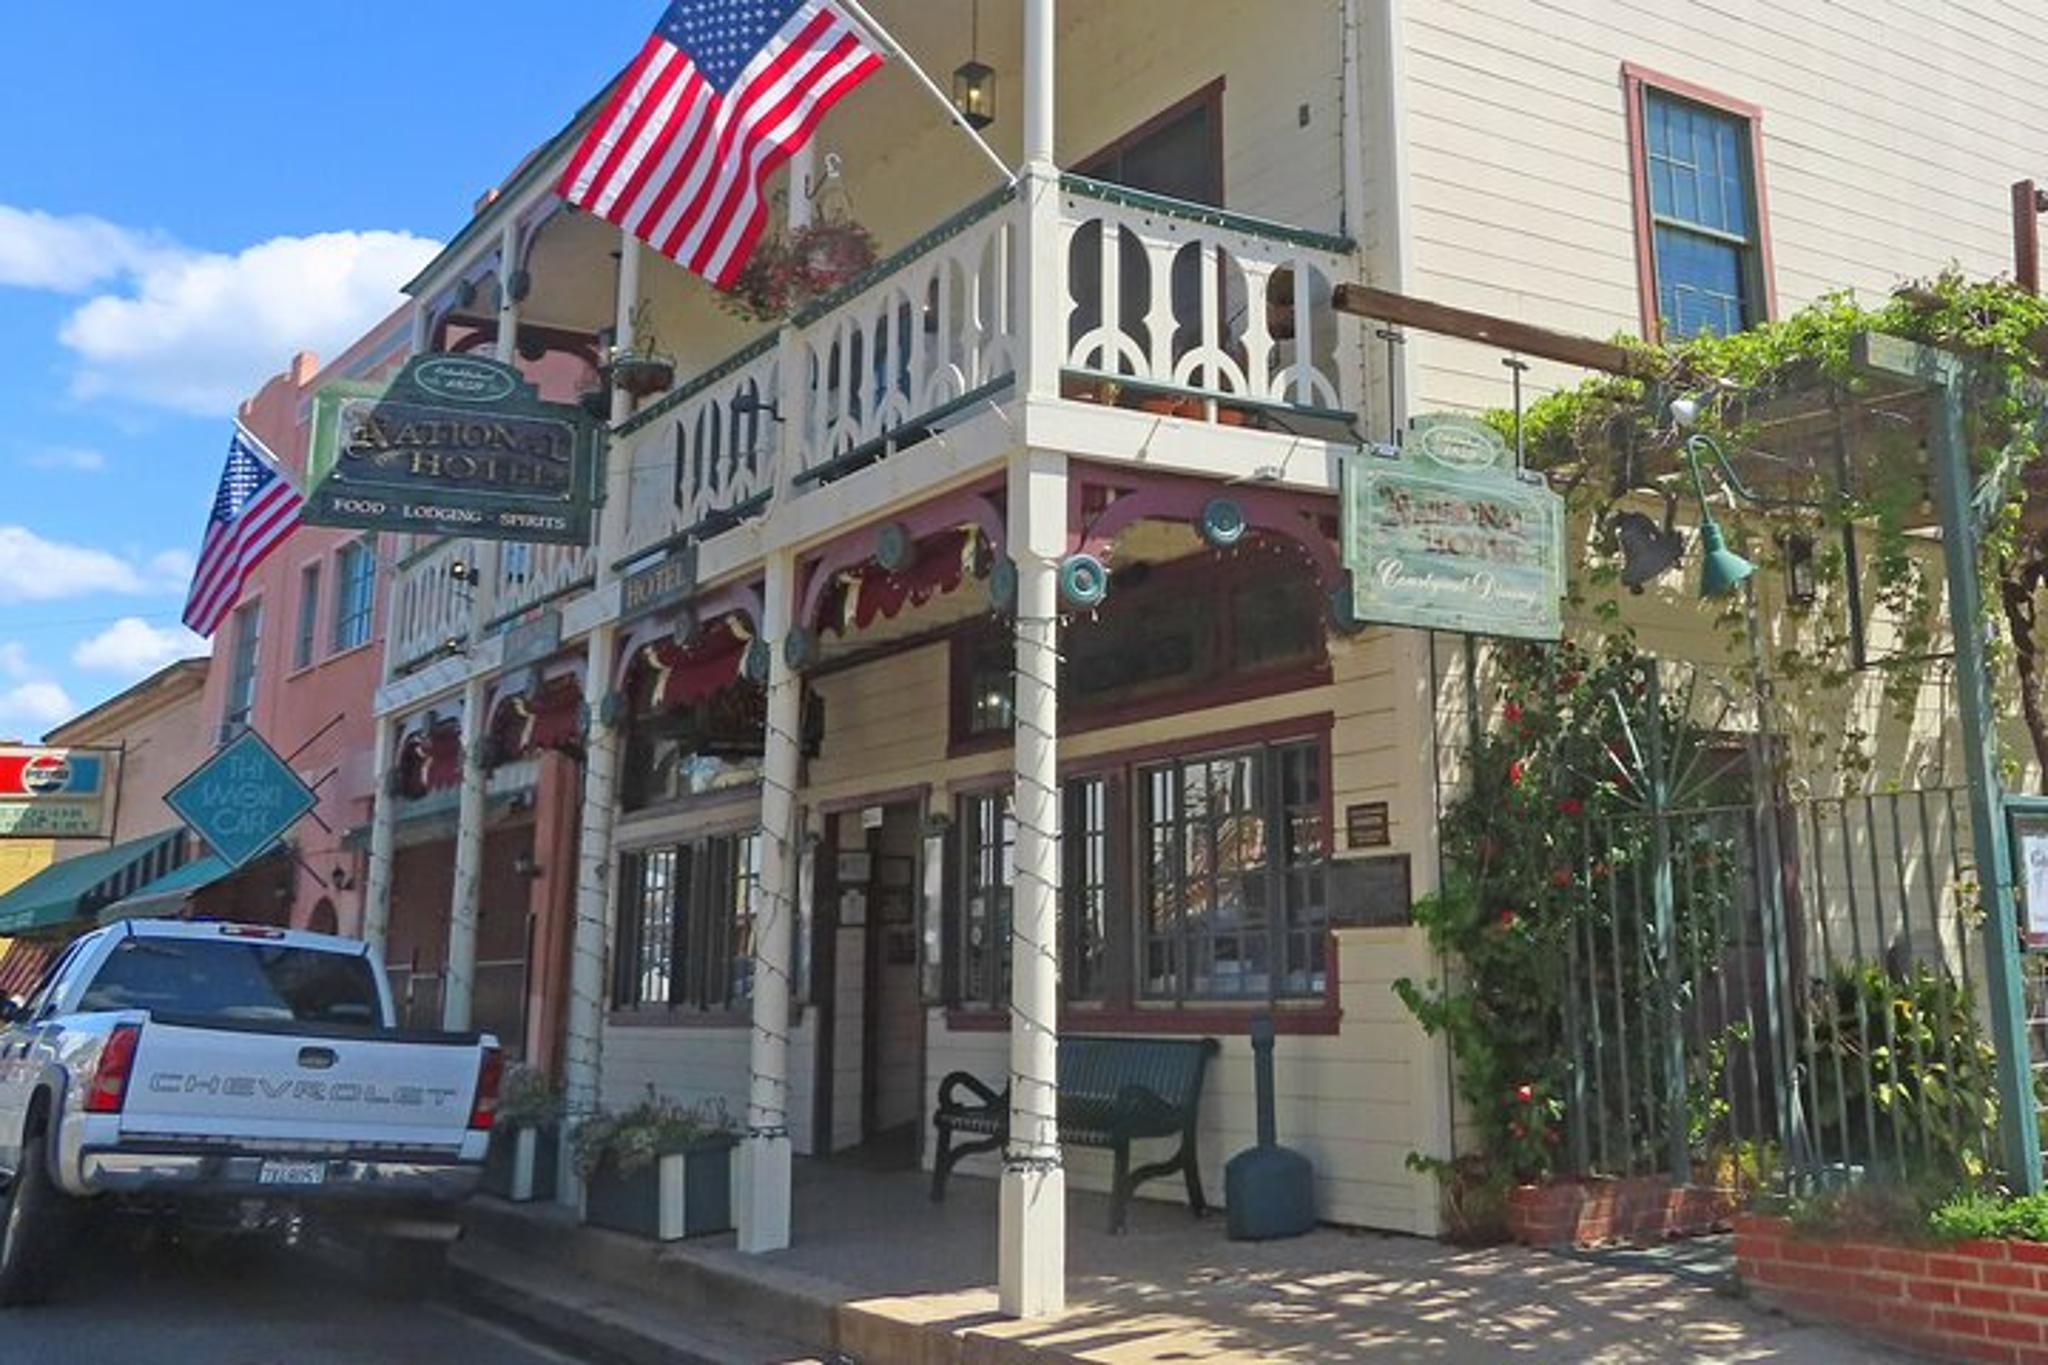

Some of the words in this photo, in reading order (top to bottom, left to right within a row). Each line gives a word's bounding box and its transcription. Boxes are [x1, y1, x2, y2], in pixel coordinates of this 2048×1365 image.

[333, 500, 386, 514] FOOD
[402, 505, 483, 523] LODGING
[499, 511, 567, 530] SPIRITS
[626, 561, 686, 609] HOTEL
[149, 1072, 457, 1107] CHEVROLET
